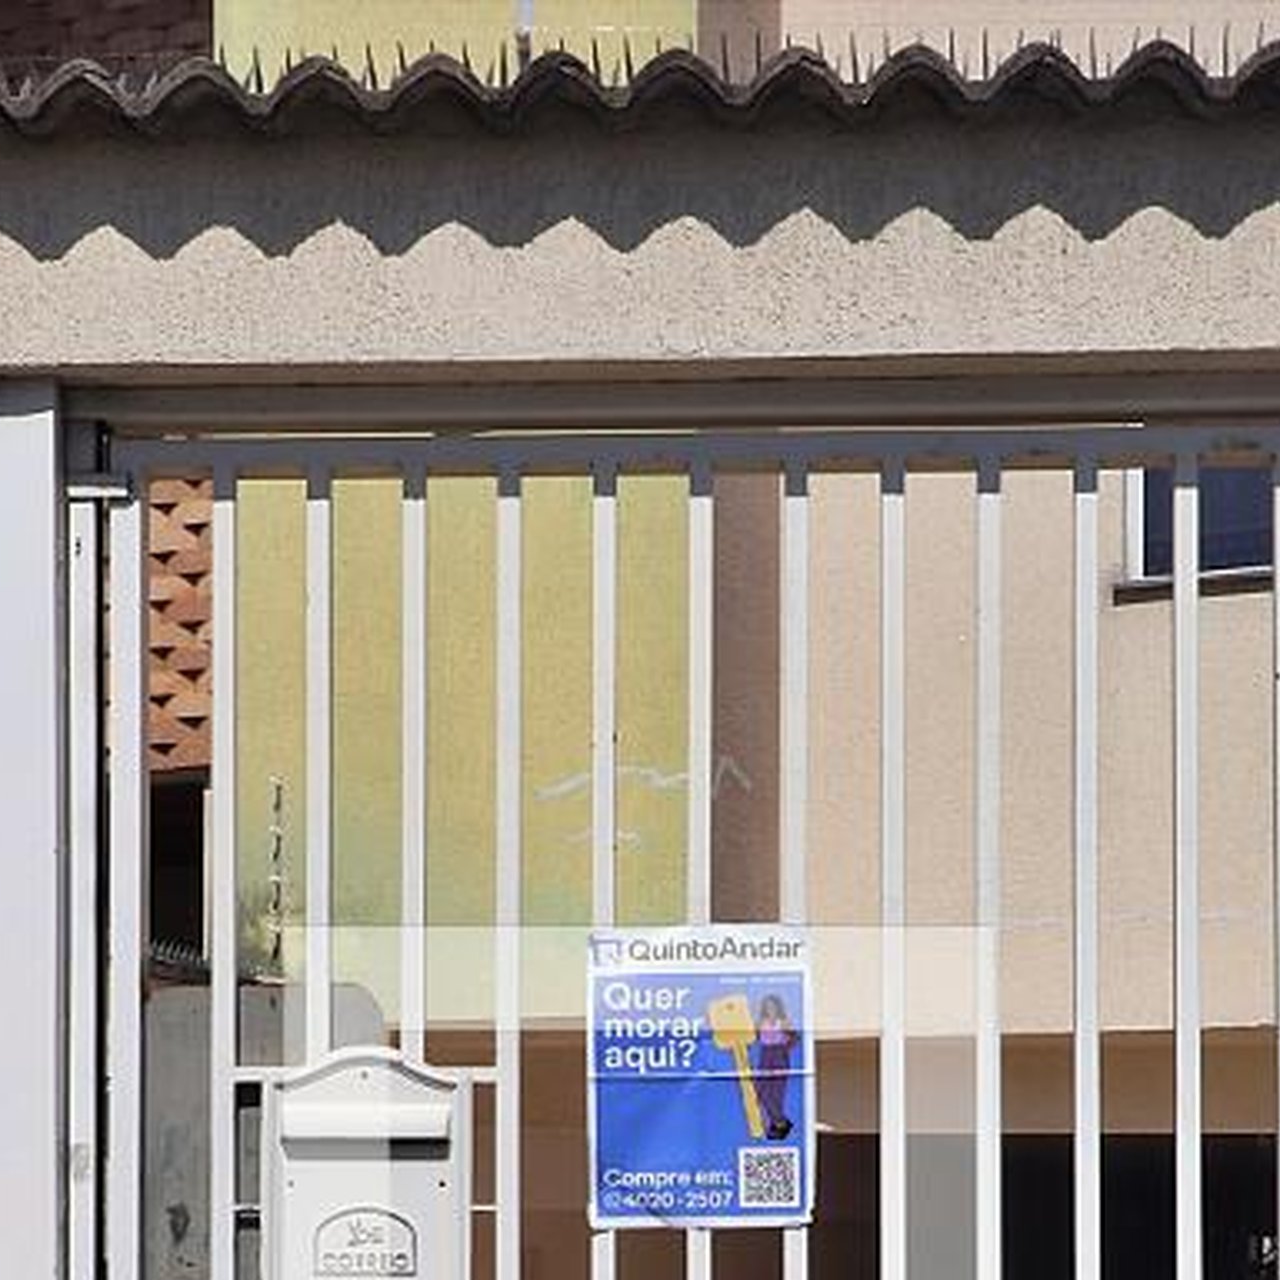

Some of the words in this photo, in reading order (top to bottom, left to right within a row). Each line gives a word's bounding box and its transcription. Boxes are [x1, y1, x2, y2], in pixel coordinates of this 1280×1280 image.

[628, 937, 801, 961] QuintoAndar
[603, 982, 691, 1011] Quer
[603, 1016, 703, 1039] morar
[604, 1040, 697, 1073] aqui?
[603, 1168, 690, 1189] Compre
